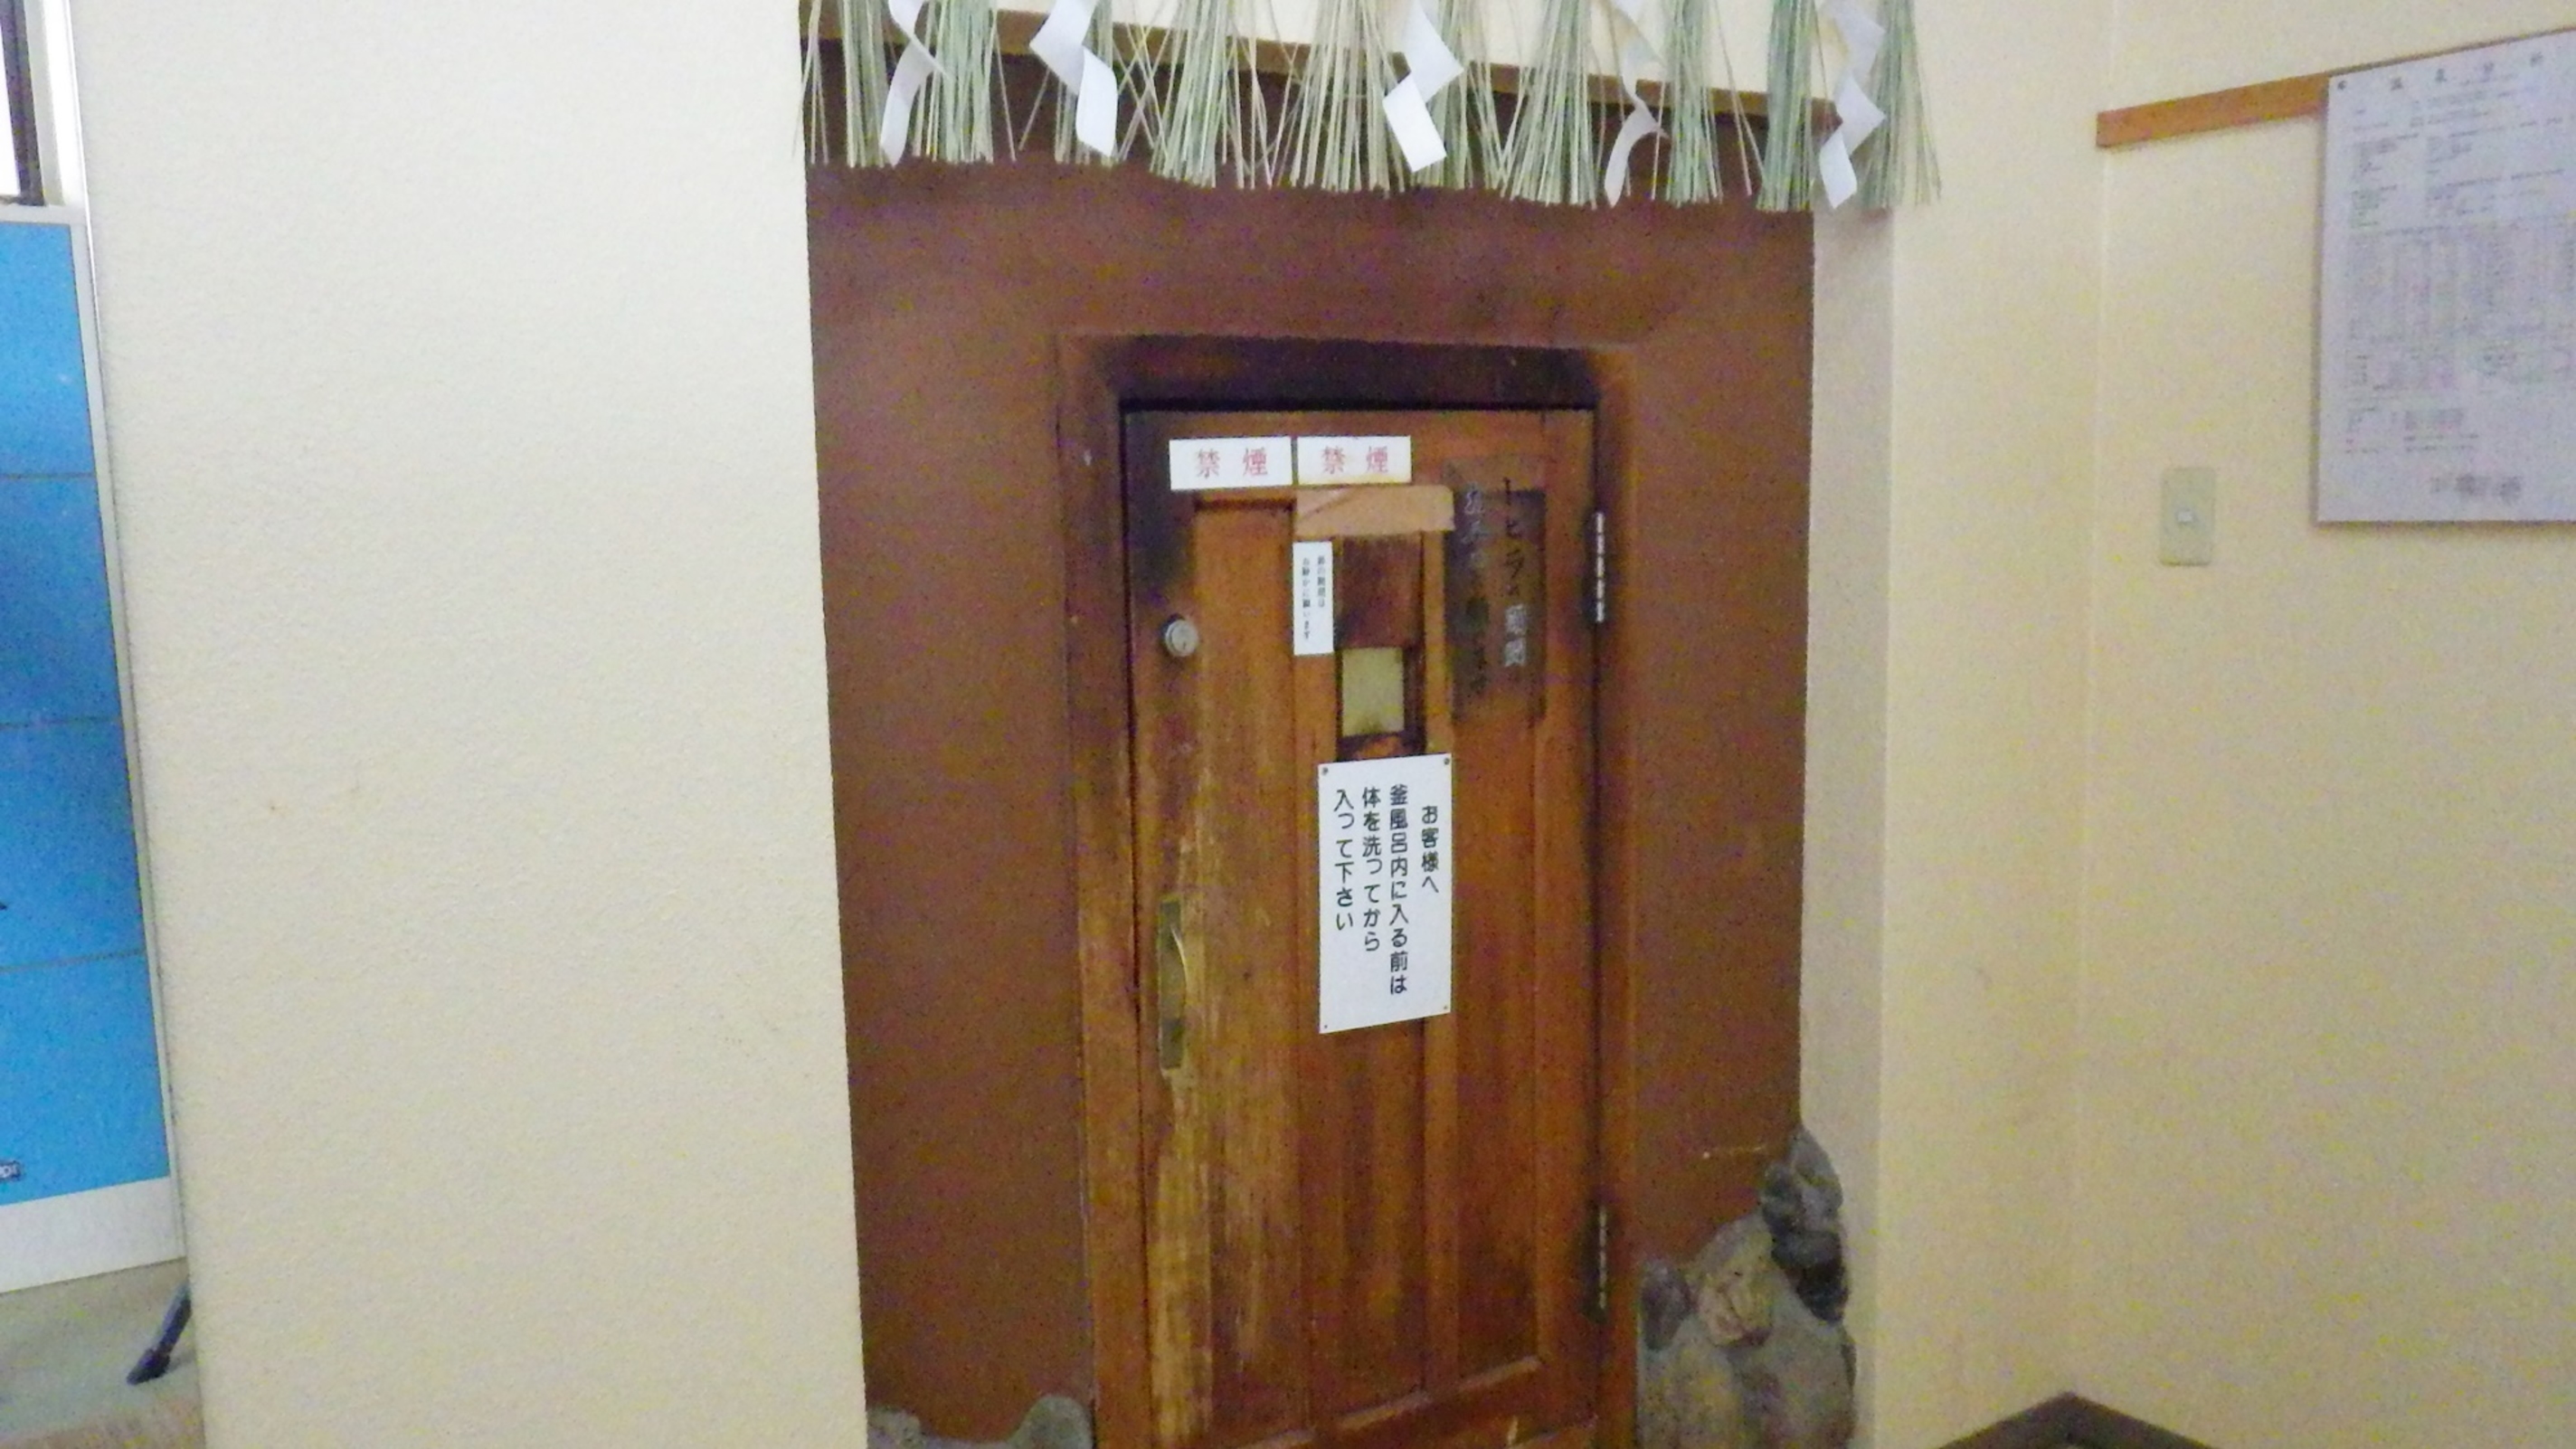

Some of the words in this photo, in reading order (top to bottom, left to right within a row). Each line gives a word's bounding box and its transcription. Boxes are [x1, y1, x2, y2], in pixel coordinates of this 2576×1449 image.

[1197, 446, 1269, 479] 禁煙
[1321, 445, 1389, 476] 禁煙
[1333, 789, 1355, 932] 入って下さい
[1362, 786, 1383, 952] 体を洗ってから
[1389, 783, 1409, 995] 釜風呂内に入る前は
[1421, 805, 1439, 894] お客様へ
